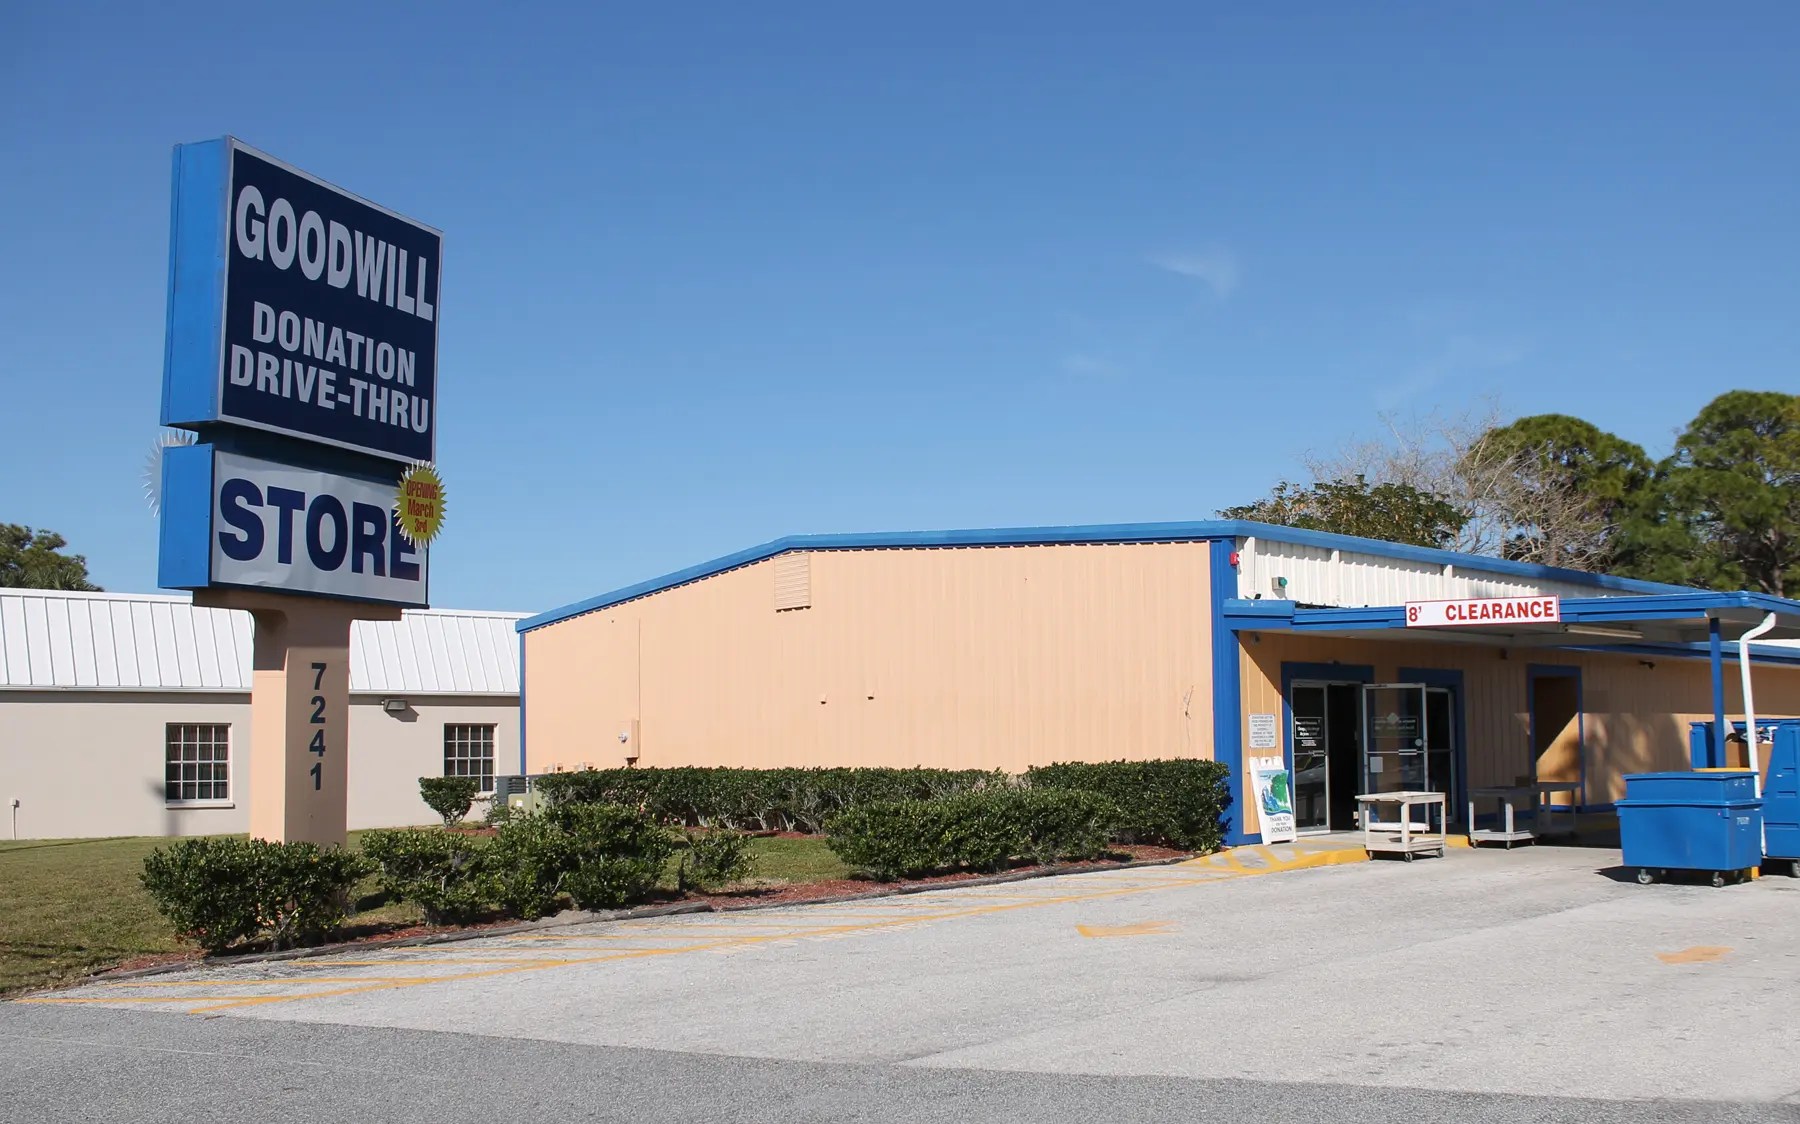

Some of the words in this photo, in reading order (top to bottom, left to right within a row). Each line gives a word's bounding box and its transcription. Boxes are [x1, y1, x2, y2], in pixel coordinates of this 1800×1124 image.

[235, 185, 433, 322] GOODWILL
[252, 301, 416, 387] DONATION
[230, 343, 429, 434] DRIVE-THRU
[406, 480, 438, 500] OPENING
[407, 499, 434, 518] March
[219, 478, 420, 582] STORE
[415, 518, 428, 533] 3rd
[1445, 601, 1555, 621] CLEARANCE
[1271, 825, 1292, 833] DONATION
